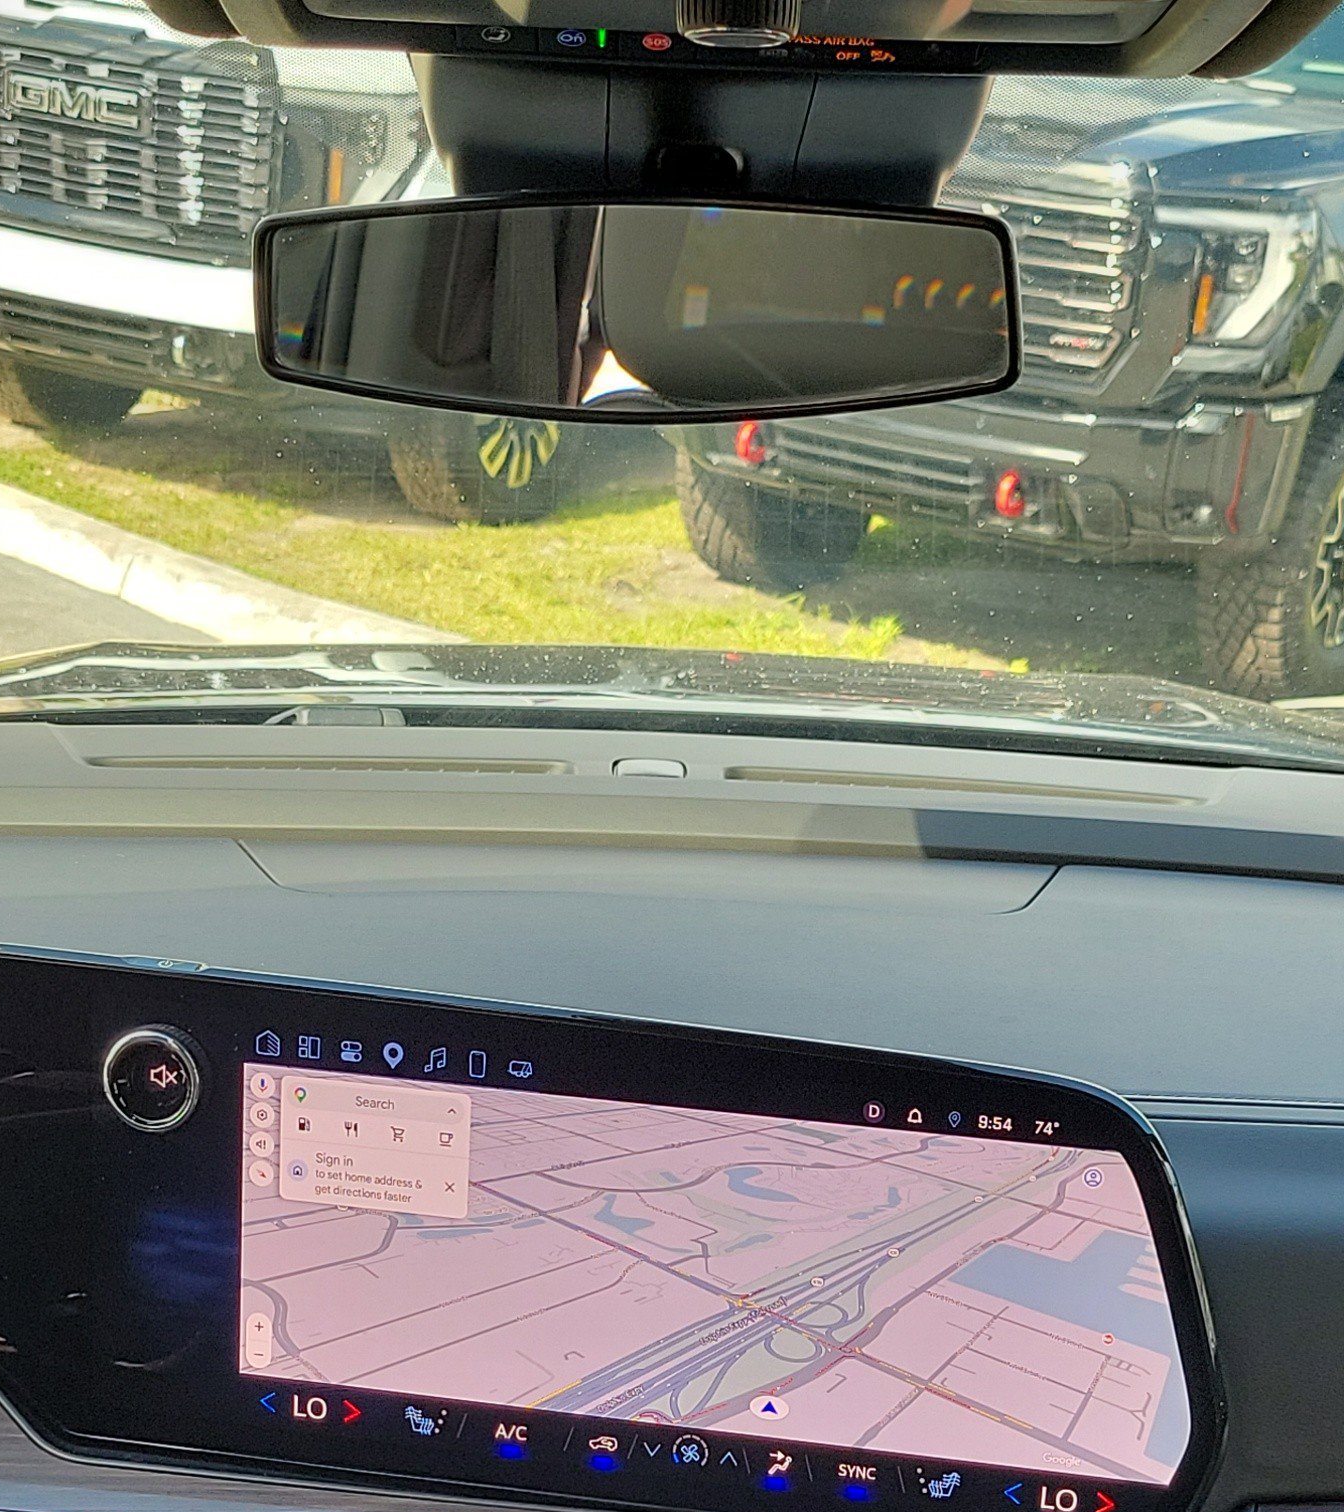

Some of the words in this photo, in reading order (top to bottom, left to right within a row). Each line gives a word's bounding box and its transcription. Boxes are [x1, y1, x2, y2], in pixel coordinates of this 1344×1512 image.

[647, 37, 669, 47] SOS
[824, 36, 845, 46] AIR
[848, 37, 875, 47] BAG
[836, 51, 860, 61] OFF
[10, 74, 138, 129] GMC
[355, 1096, 395, 1111] Search
[868, 1104, 880, 1118] D
[978, 1114, 1013, 1131] 9:54
[1034, 1120, 1060, 1136] 74°
[315, 1152, 341, 1167] Sign
[342, 1154, 354, 1167] in
[315, 1169, 325, 1179] to
[327, 1171, 343, 1181] set
[344, 1172, 372, 1184] home
[373, 1175, 413, 1189] address
[414, 1179, 423, 1189] &
[314, 1185, 331, 1196] get
[332, 1186, 382, 1200] directions
[383, 1189, 412, 1203] faster
[293, 1394, 328, 1419] LO
[494, 1423, 528, 1441] A/C
[1042, 1452, 1081, 1468] Google
[837, 1463, 877, 1480] SYNC
[1040, 1486, 1078, 1512] LO
